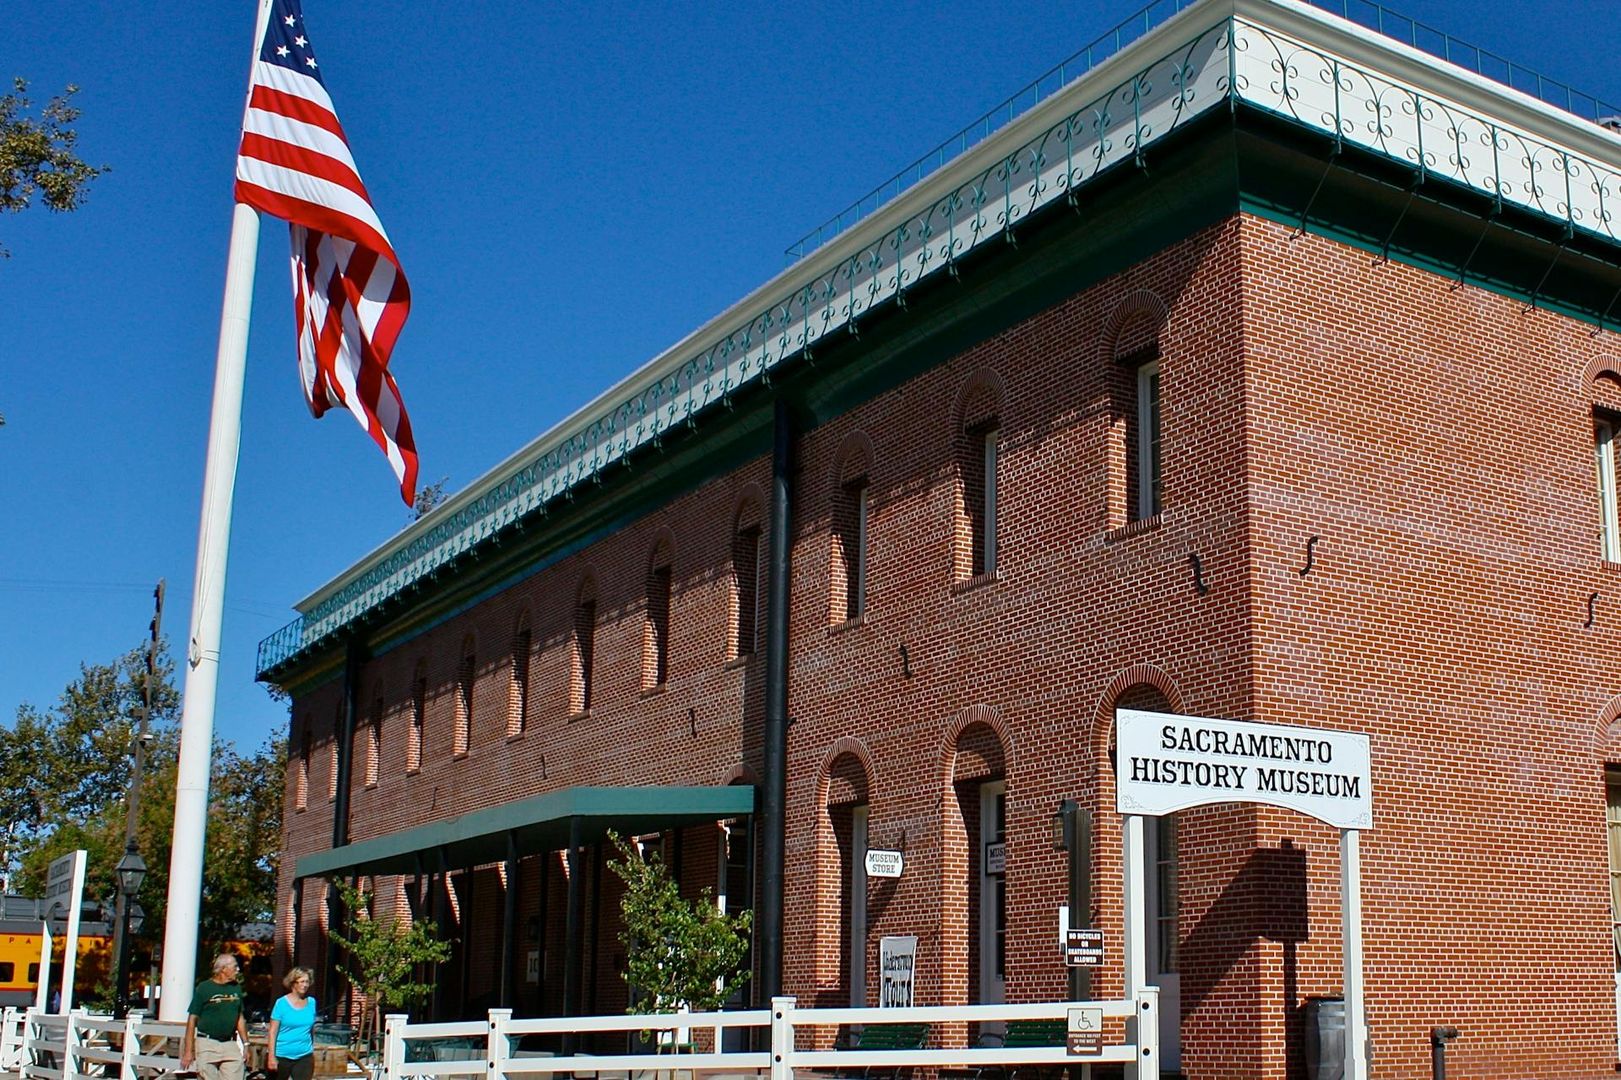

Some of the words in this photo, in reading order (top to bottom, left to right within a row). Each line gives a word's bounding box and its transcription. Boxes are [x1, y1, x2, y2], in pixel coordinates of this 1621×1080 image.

[1161, 726, 1333, 764] SACRAMENTO
[1130, 757, 1248, 789] HISTORY
[1257, 768, 1361, 799] MUSEUM
[869, 853, 900, 864] MUSEUM
[872, 864, 896, 874] STORE
